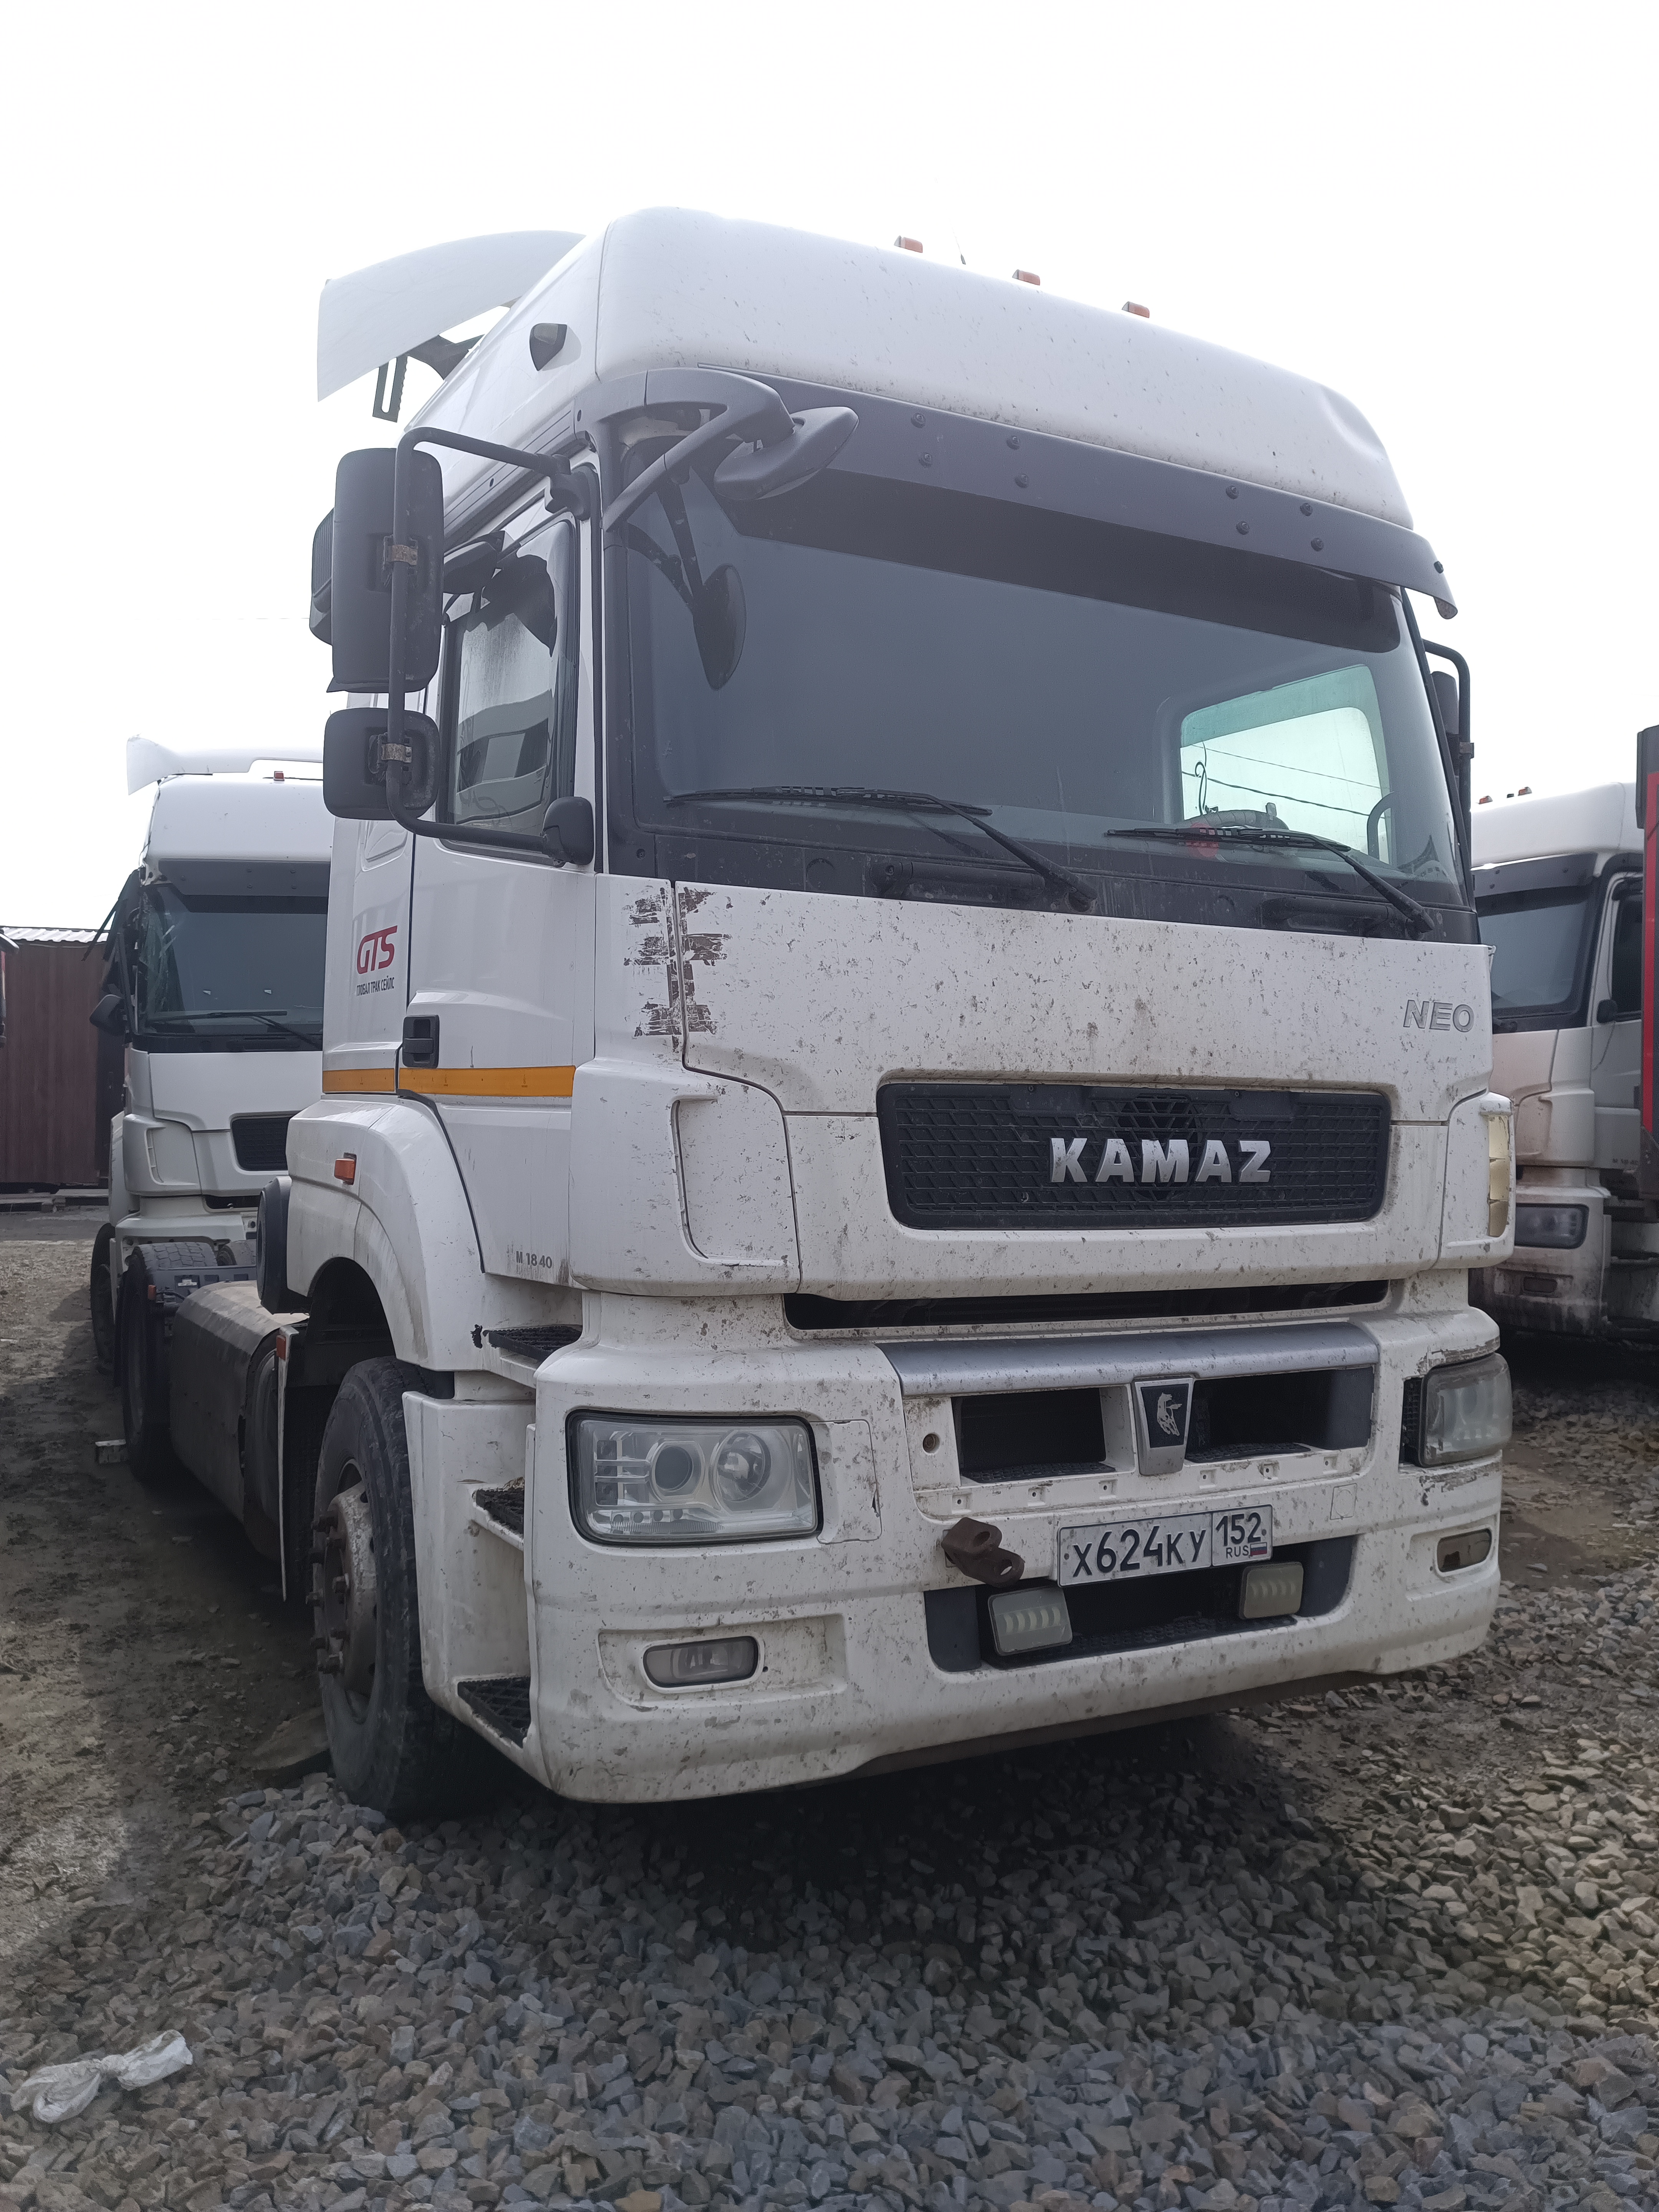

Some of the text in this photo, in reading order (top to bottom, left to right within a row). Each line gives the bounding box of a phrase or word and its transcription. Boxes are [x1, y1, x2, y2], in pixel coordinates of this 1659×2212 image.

[357, 925, 397, 974] GTS
[371, 980, 380, 993] ТРАК
[381, 975, 394, 991] СЕЙЛС
[1403, 999, 1474, 1032] NEO
[1050, 1138, 1271, 1182] KAMAZ
[516, 1251, 523, 1263] M
[1216, 1512, 1261, 1546] 152
[1226, 1545, 1249, 1558] RUS
